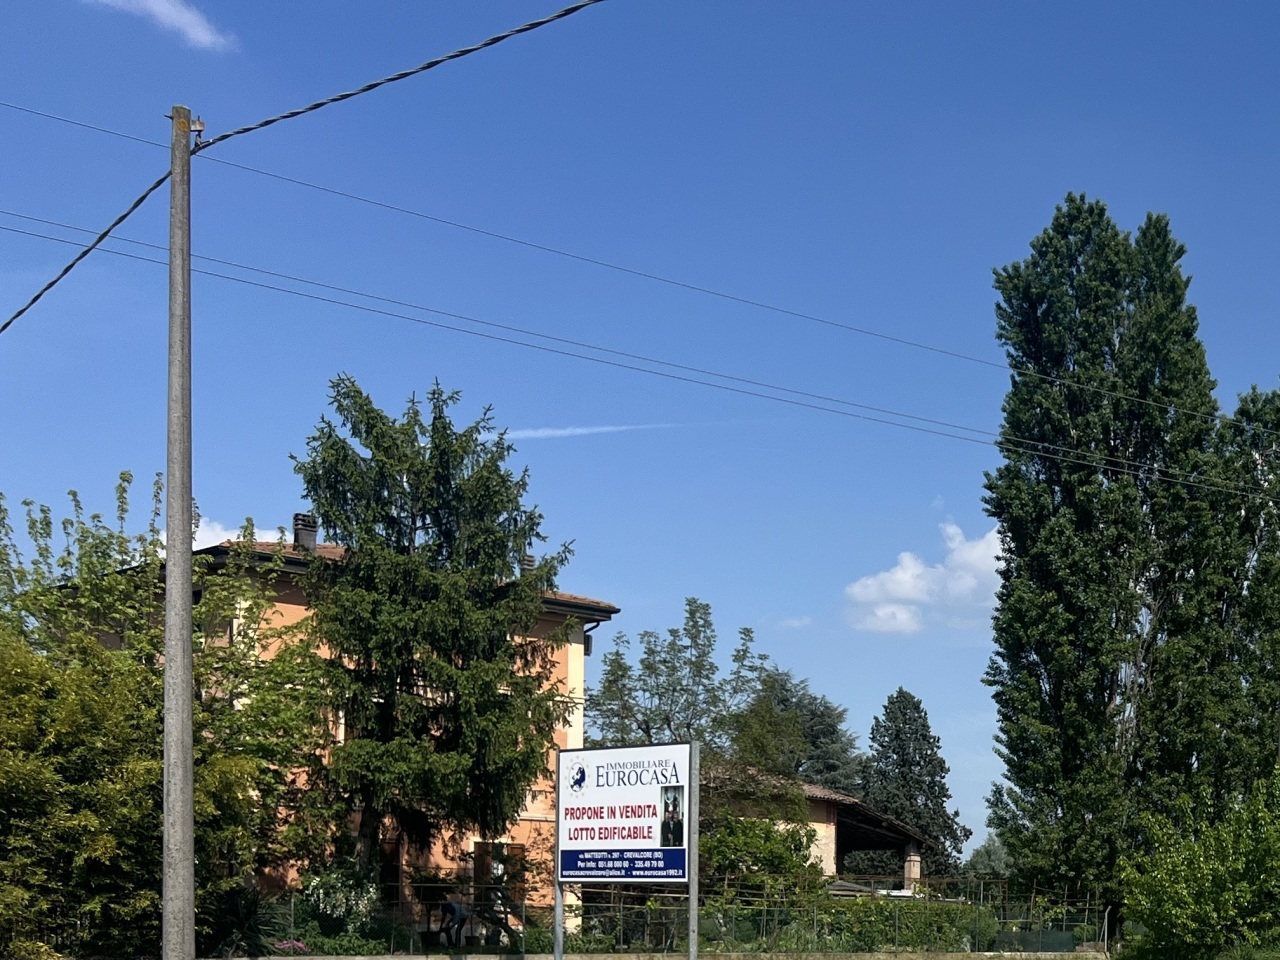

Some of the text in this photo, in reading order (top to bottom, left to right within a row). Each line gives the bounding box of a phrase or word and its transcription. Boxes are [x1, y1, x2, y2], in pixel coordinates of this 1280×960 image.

[606, 759, 671, 771] IMMOBILIARE
[595, 761, 680, 787] EUROCASA
[564, 804, 658, 821] PROPONE IN VENDITA
[568, 825, 653, 841] LOTTO EDIFICABILE
[623, 851, 653, 859] CREVALCORE
[577, 860, 585, 868] Per
